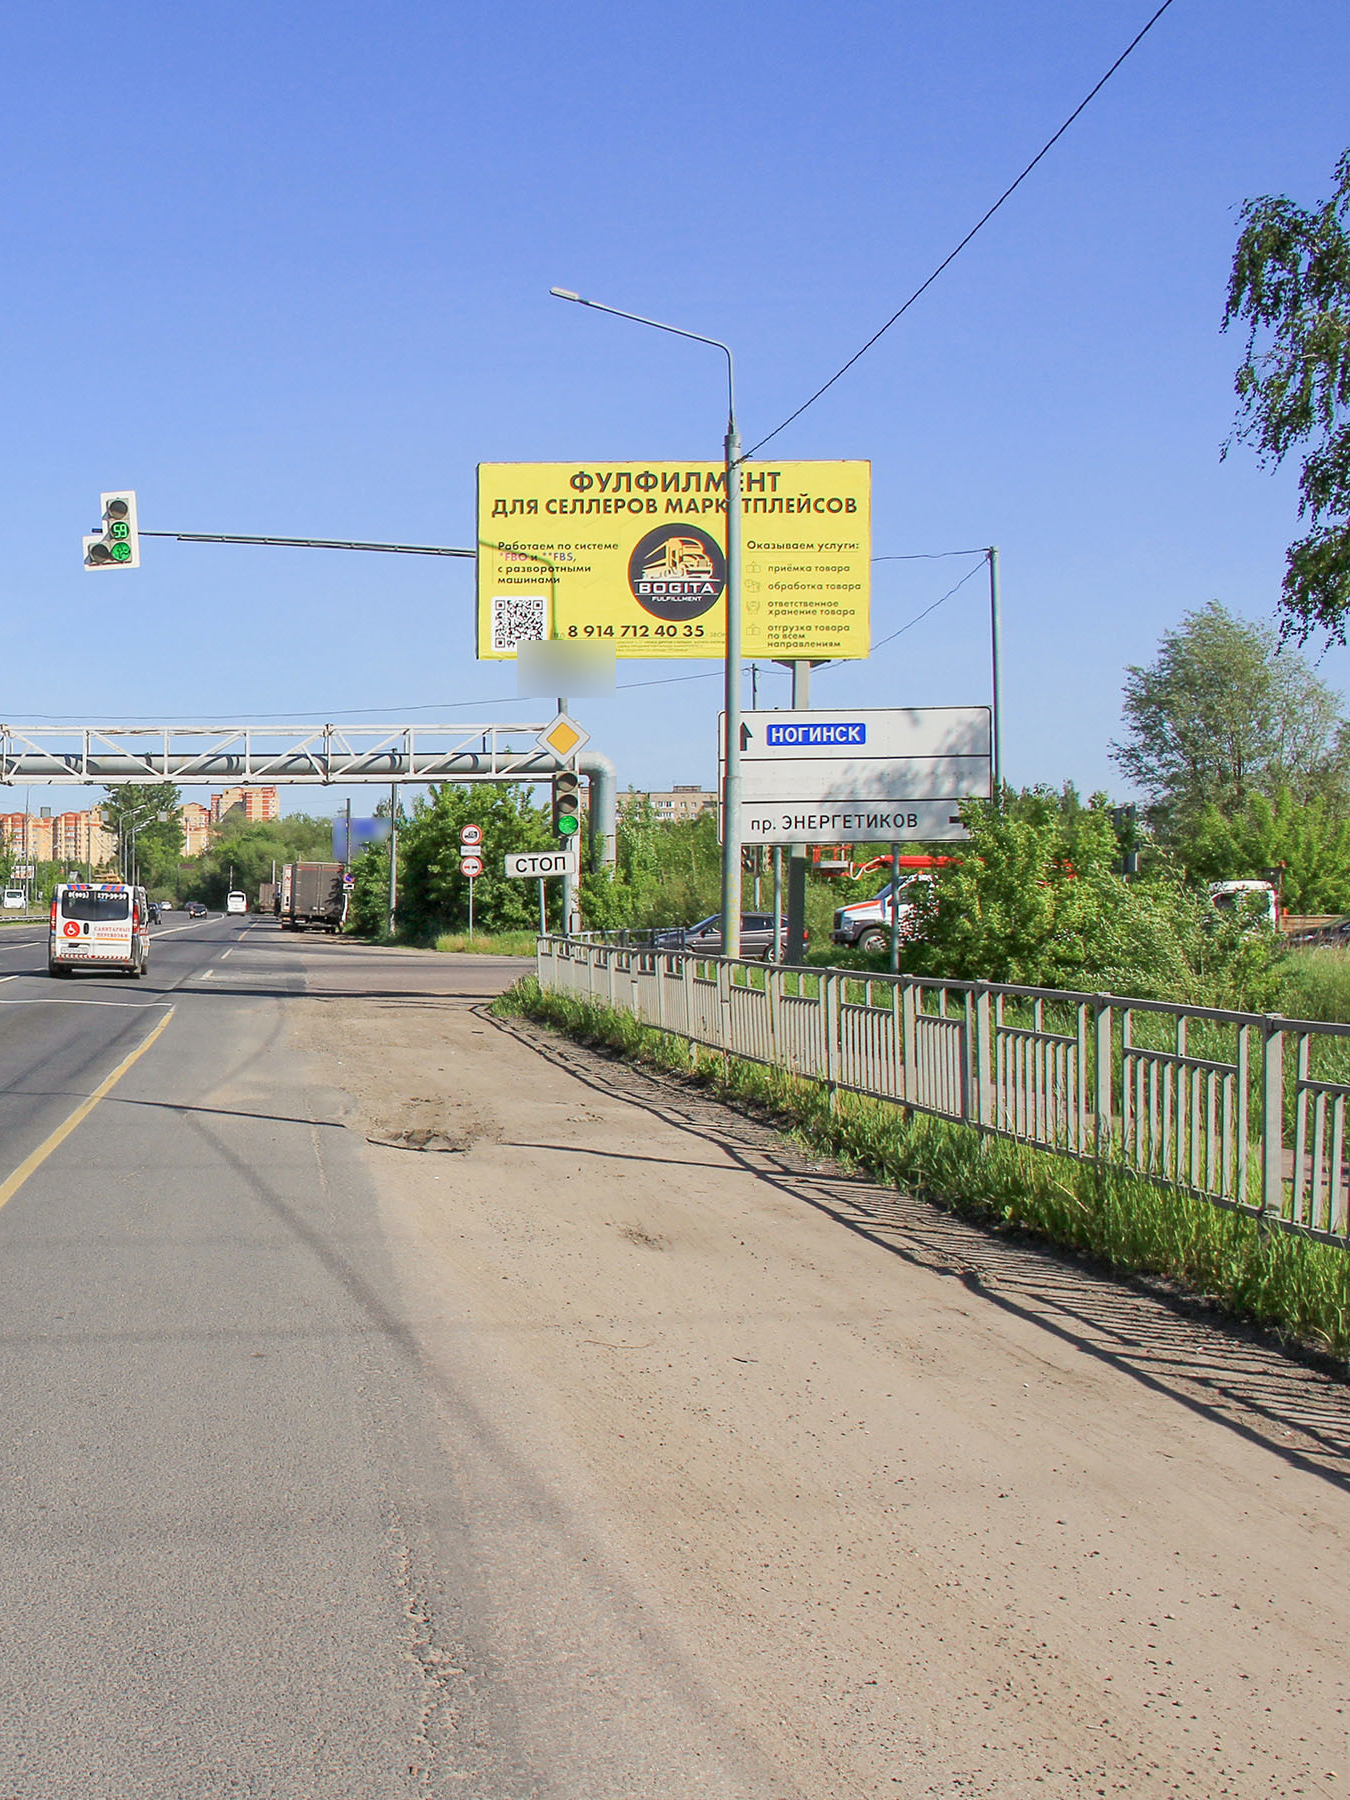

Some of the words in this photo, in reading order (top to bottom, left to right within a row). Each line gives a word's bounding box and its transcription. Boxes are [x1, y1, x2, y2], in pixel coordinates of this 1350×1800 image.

[491, 498, 538, 518] ДЛЯ
[545, 498, 658, 514] СЕЛЛЕРОВ
[664, 493, 857, 514] МАРКТПЛЕЙСОВ
[113, 523, 127, 538] 59
[498, 541, 554, 551] Работаем
[574, 543, 619, 551] системе
[747, 540, 814, 550] Оказываем
[817, 542, 859, 552] услуги:
[505, 566, 591, 575] разворотными
[768, 563, 812, 574] приёмка
[815, 565, 850, 574] товара
[638, 583, 715, 594] BOGITA
[768, 581, 823, 592] обработка
[825, 584, 861, 592] товара
[768, 609, 817, 618] хранение
[820, 609, 856, 618] товара
[568, 625, 579, 638] 8
[583, 625, 615, 638] 914
[620, 625, 650, 638] 712
[654, 625, 678, 638] 40
[682, 625, 705, 638] 35
[767, 625, 812, 633] отгрузка
[815, 625, 850, 633] товара
[767, 641, 841, 650] направлениям
[771, 726, 861, 743] НОГИНСК
[751, 819, 776, 833] пр.
[782, 813, 918, 830] ЭНЕРГЕТИКОВ
[515, 856, 566, 873] СТОП
